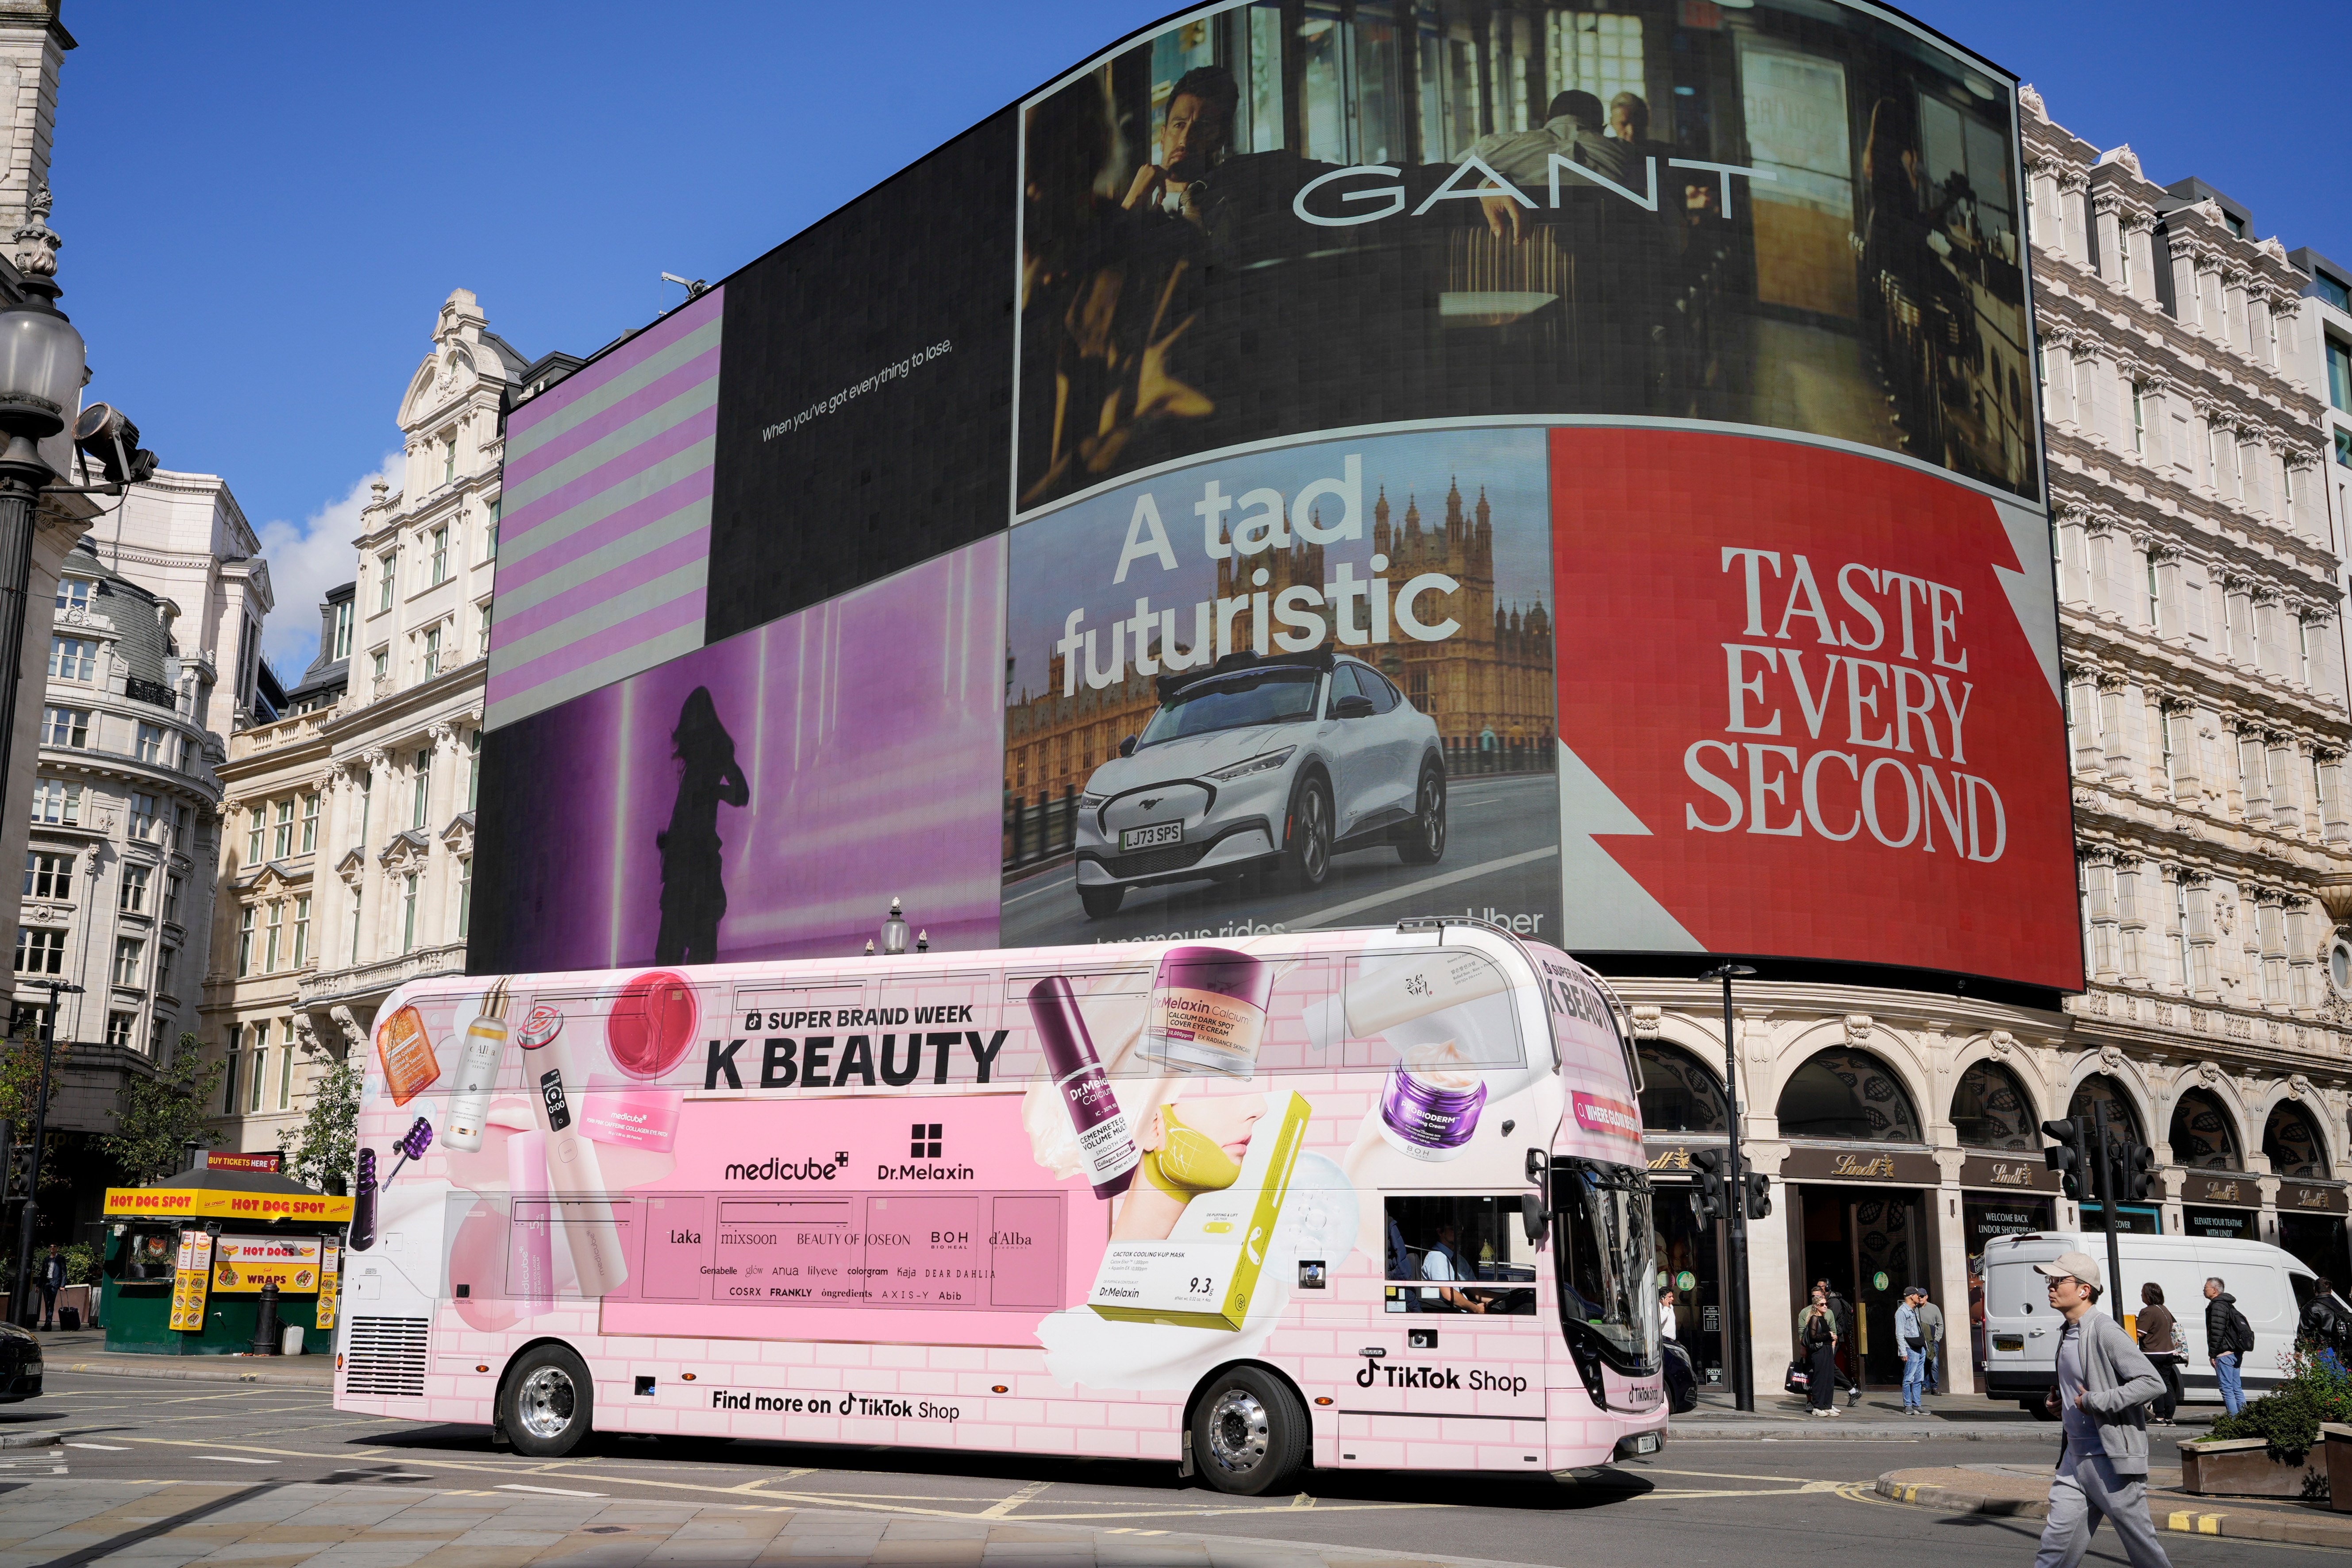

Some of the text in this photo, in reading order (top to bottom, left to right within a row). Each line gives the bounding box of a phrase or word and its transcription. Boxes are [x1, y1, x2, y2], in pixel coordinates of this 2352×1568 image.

[1293, 153, 1778, 226] GANT
[762, 339, 952, 442] When you've got everything to lose,
[1112, 454, 1363, 585] A tad
[1721, 546, 1967, 673] TASTE
[1057, 554, 1462, 697] futuristic
[1721, 643, 1973, 765] EVERY
[1684, 740, 2006, 863] SECOND
[1127, 825, 1179, 847] LJ73 SPS
[1219, 919, 1286, 937] rides
[768, 1005, 974, 1029] SUPER BRAND WEEK
[1152, 997, 1250, 1025] Dr.Melaxin Calcium
[1558, 981, 1614, 1036] BEAUTY
[1168, 1012, 1235, 1030] CALCIUM DARK SPOT
[1170, 1019, 1229, 1037] COVER EYE CREAM
[1168, 1029, 1193, 1039] 10,000ppm
[1206, 1036, 1232, 1048] RADIANCE
[1233, 1043, 1251, 1055] SKINCARE
[391, 1058, 406, 1071] Retinal
[393, 1063, 410, 1077] Capsule
[410, 1052, 423, 1067] Serum
[704, 1029, 1010, 1090] K BEAUTY
[543, 1078, 560, 1089] BOOSTER
[548, 1100, 565, 1113] 0:00
[611, 1112, 643, 1123] medicube
[1413, 1116, 1428, 1127] Lifting
[1585, 1104, 1609, 1124] WHERE
[1608, 1110, 1625, 1128] GLOW
[604, 1121, 625, 1129] CAFFEINE
[626, 1125, 650, 1134] COLLAGEN
[1080, 1120, 1120, 1145] CEMENRETE
[1082, 1131, 1113, 1151] VOLUME
[1095, 1139, 1120, 1156] SMOOTH
[1097, 1146, 1130, 1168] Collagen Extract
[1407, 1145, 1430, 1156] BOH
[223, 1158, 250, 1166] TICKETS
[726, 1157, 836, 1180] medicube
[1832, 1154, 1883, 1177] Lindt
[878, 1163, 974, 1180] Dr.Melaxin
[1990, 1163, 2024, 1186] Lindt
[2205, 1182, 2233, 1202] Lindt
[2298, 1189, 2322, 1208] Lindt
[110, 1195, 191, 1208] HOT DOG SPOT
[231, 1198, 326, 1214] HOT DOG SPOT
[330, 1203, 350, 1214] smoothies
[1986, 1213, 2029, 1223] WELCOME BACK
[2115, 1220, 2131, 1229] COVER
[2194, 1217, 2212, 1225] ELEVATE
[2225, 1219, 2243, 1227] TEATIME
[671, 1229, 778, 1244] Laka mixsoon
[931, 1232, 968, 1243] BOH
[989, 1232, 1032, 1245] d'Alba
[1979, 1225, 2001, 1234] LINDOR
[2206, 1229, 2233, 1237] WITH LINDT
[797, 1233, 911, 1246] BEAUTY OF JOSEON
[243, 1247, 294, 1256] HOT DOGS
[590, 1233, 604, 1276] medicube
[247, 1275, 286, 1284] WRAPS
[521, 1251, 530, 1308] medicube
[701, 1266, 995, 1279] Genabelle Anua lilyeve colorgram Kaja DEAR DAHLIA
[730, 1287, 761, 1296] COSRX
[770, 1288, 812, 1297] FRANKLY
[939, 1291, 962, 1300] Abib
[1099, 1287, 1139, 1298] Dr.Melaxin
[1384, 1366, 1527, 1397] TikTok Shop
[1635, 1387, 1650, 1402] TikTok
[713, 1391, 960, 1423] Find more on TikTok Shop
